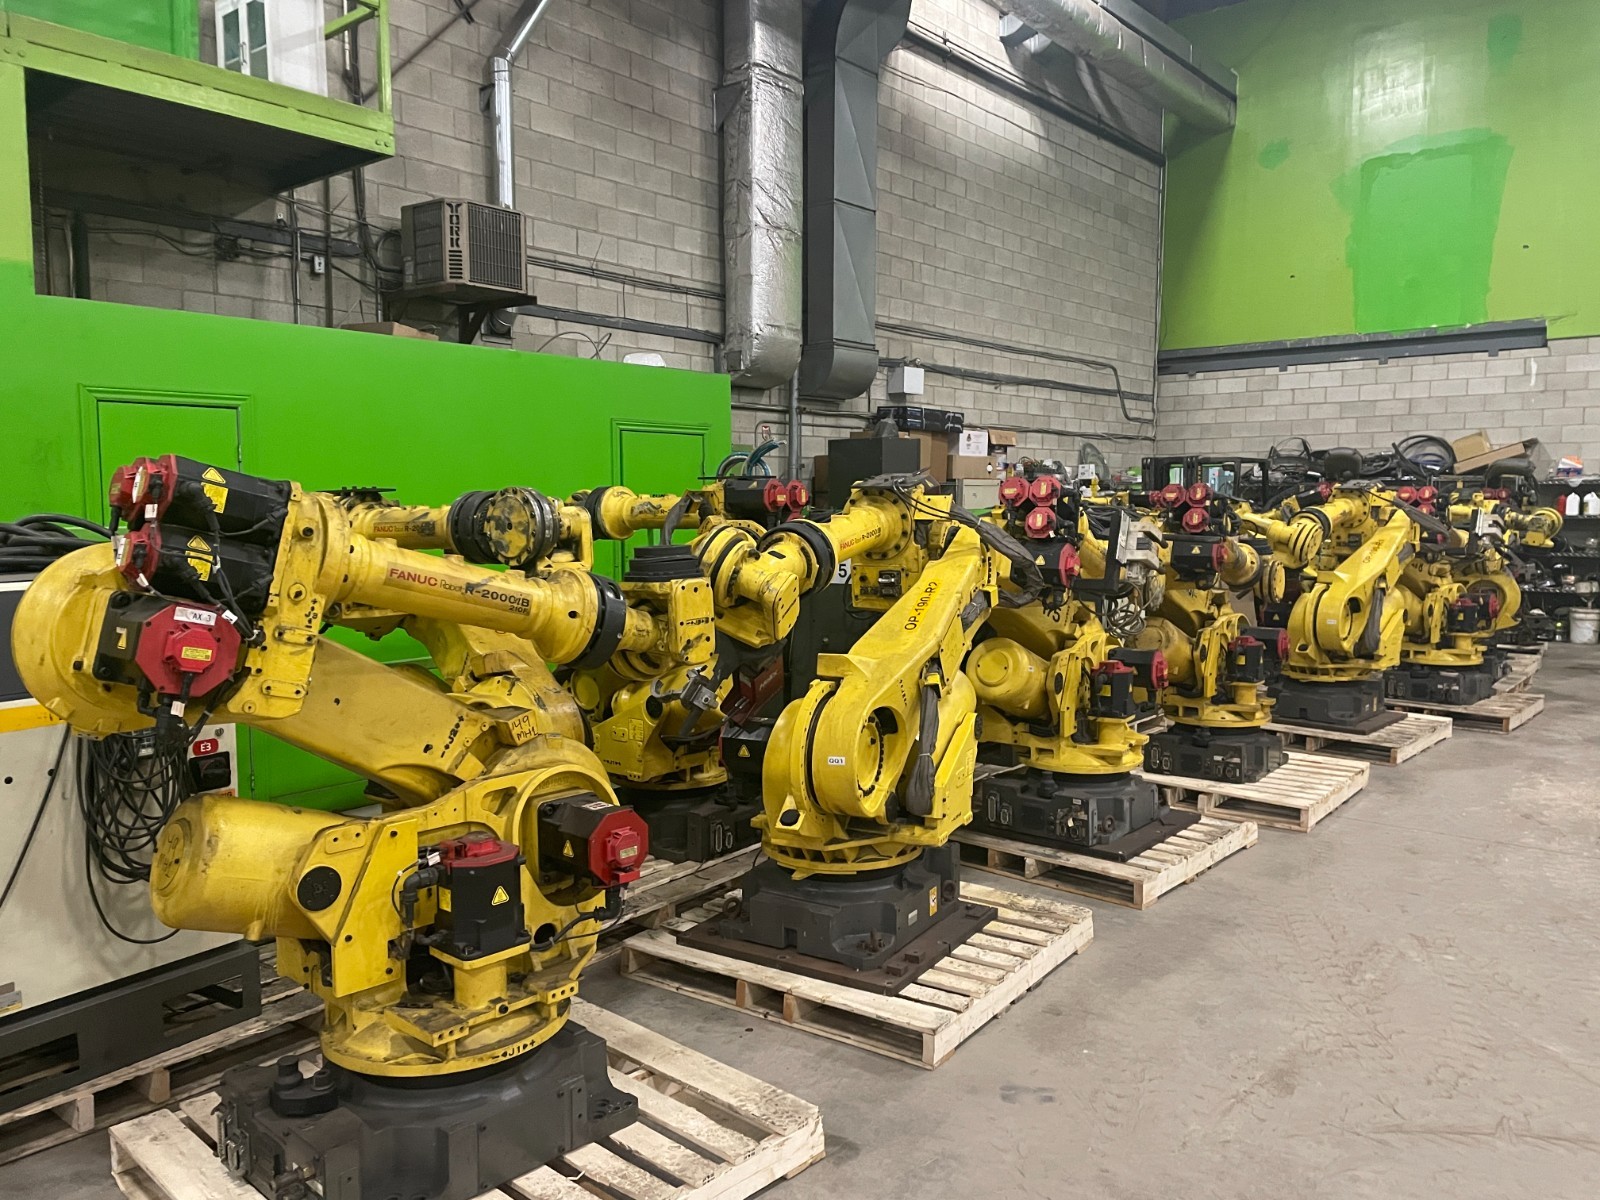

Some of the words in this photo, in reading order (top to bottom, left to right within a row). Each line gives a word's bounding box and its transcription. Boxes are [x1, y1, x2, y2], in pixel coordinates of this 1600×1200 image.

[446, 202, 462, 248] YORK
[389, 568, 438, 587] FANUC
[838, 563, 847, 577] 5
[511, 715, 531, 730] 149
[200, 742, 212, 752] E3
